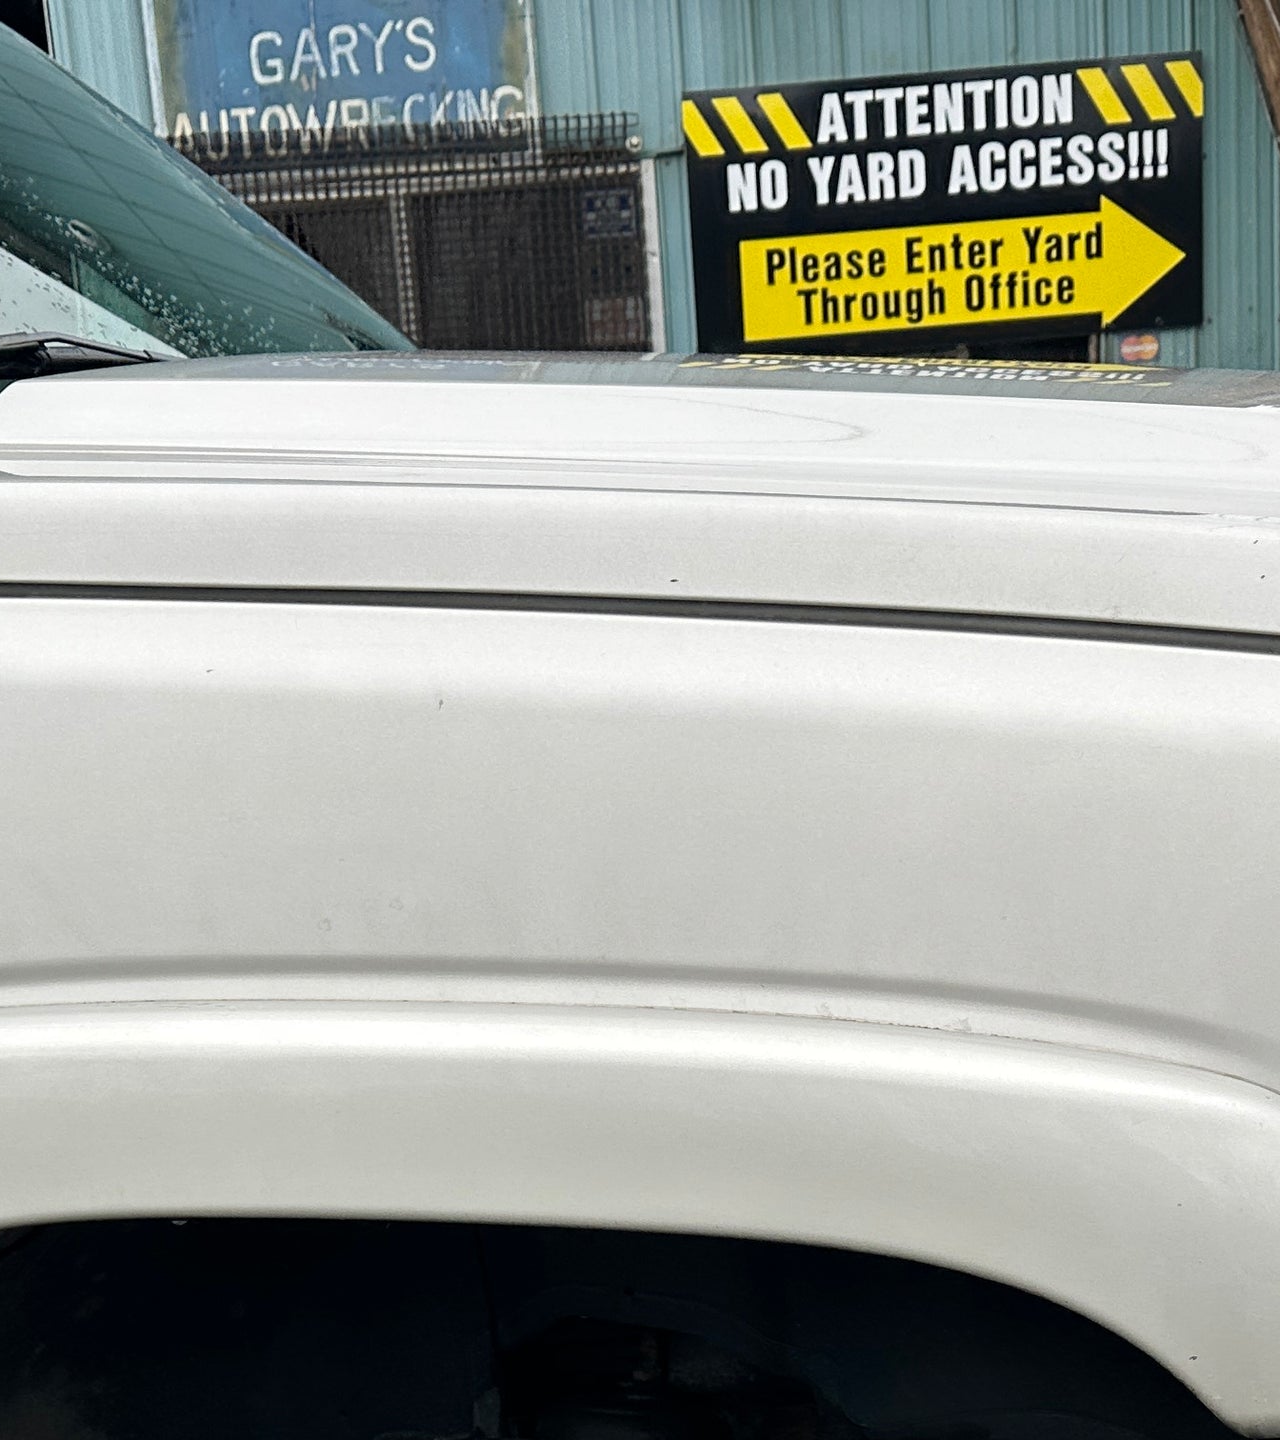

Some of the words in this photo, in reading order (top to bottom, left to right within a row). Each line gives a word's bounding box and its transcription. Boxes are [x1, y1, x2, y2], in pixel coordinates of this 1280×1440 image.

[249, 17, 438, 86] GARY'S
[816, 73, 1074, 143] ATTENTION
[726, 159, 788, 214] NO
[808, 149, 927, 206] YARD
[947, 128, 1169, 195] ACCESS!!!
[765, 244, 887, 286] Please
[905, 235, 1004, 275] Enter
[1022, 222, 1104, 264] Yard
[797, 276, 947, 326] Through
[964, 270, 1076, 313] Office
